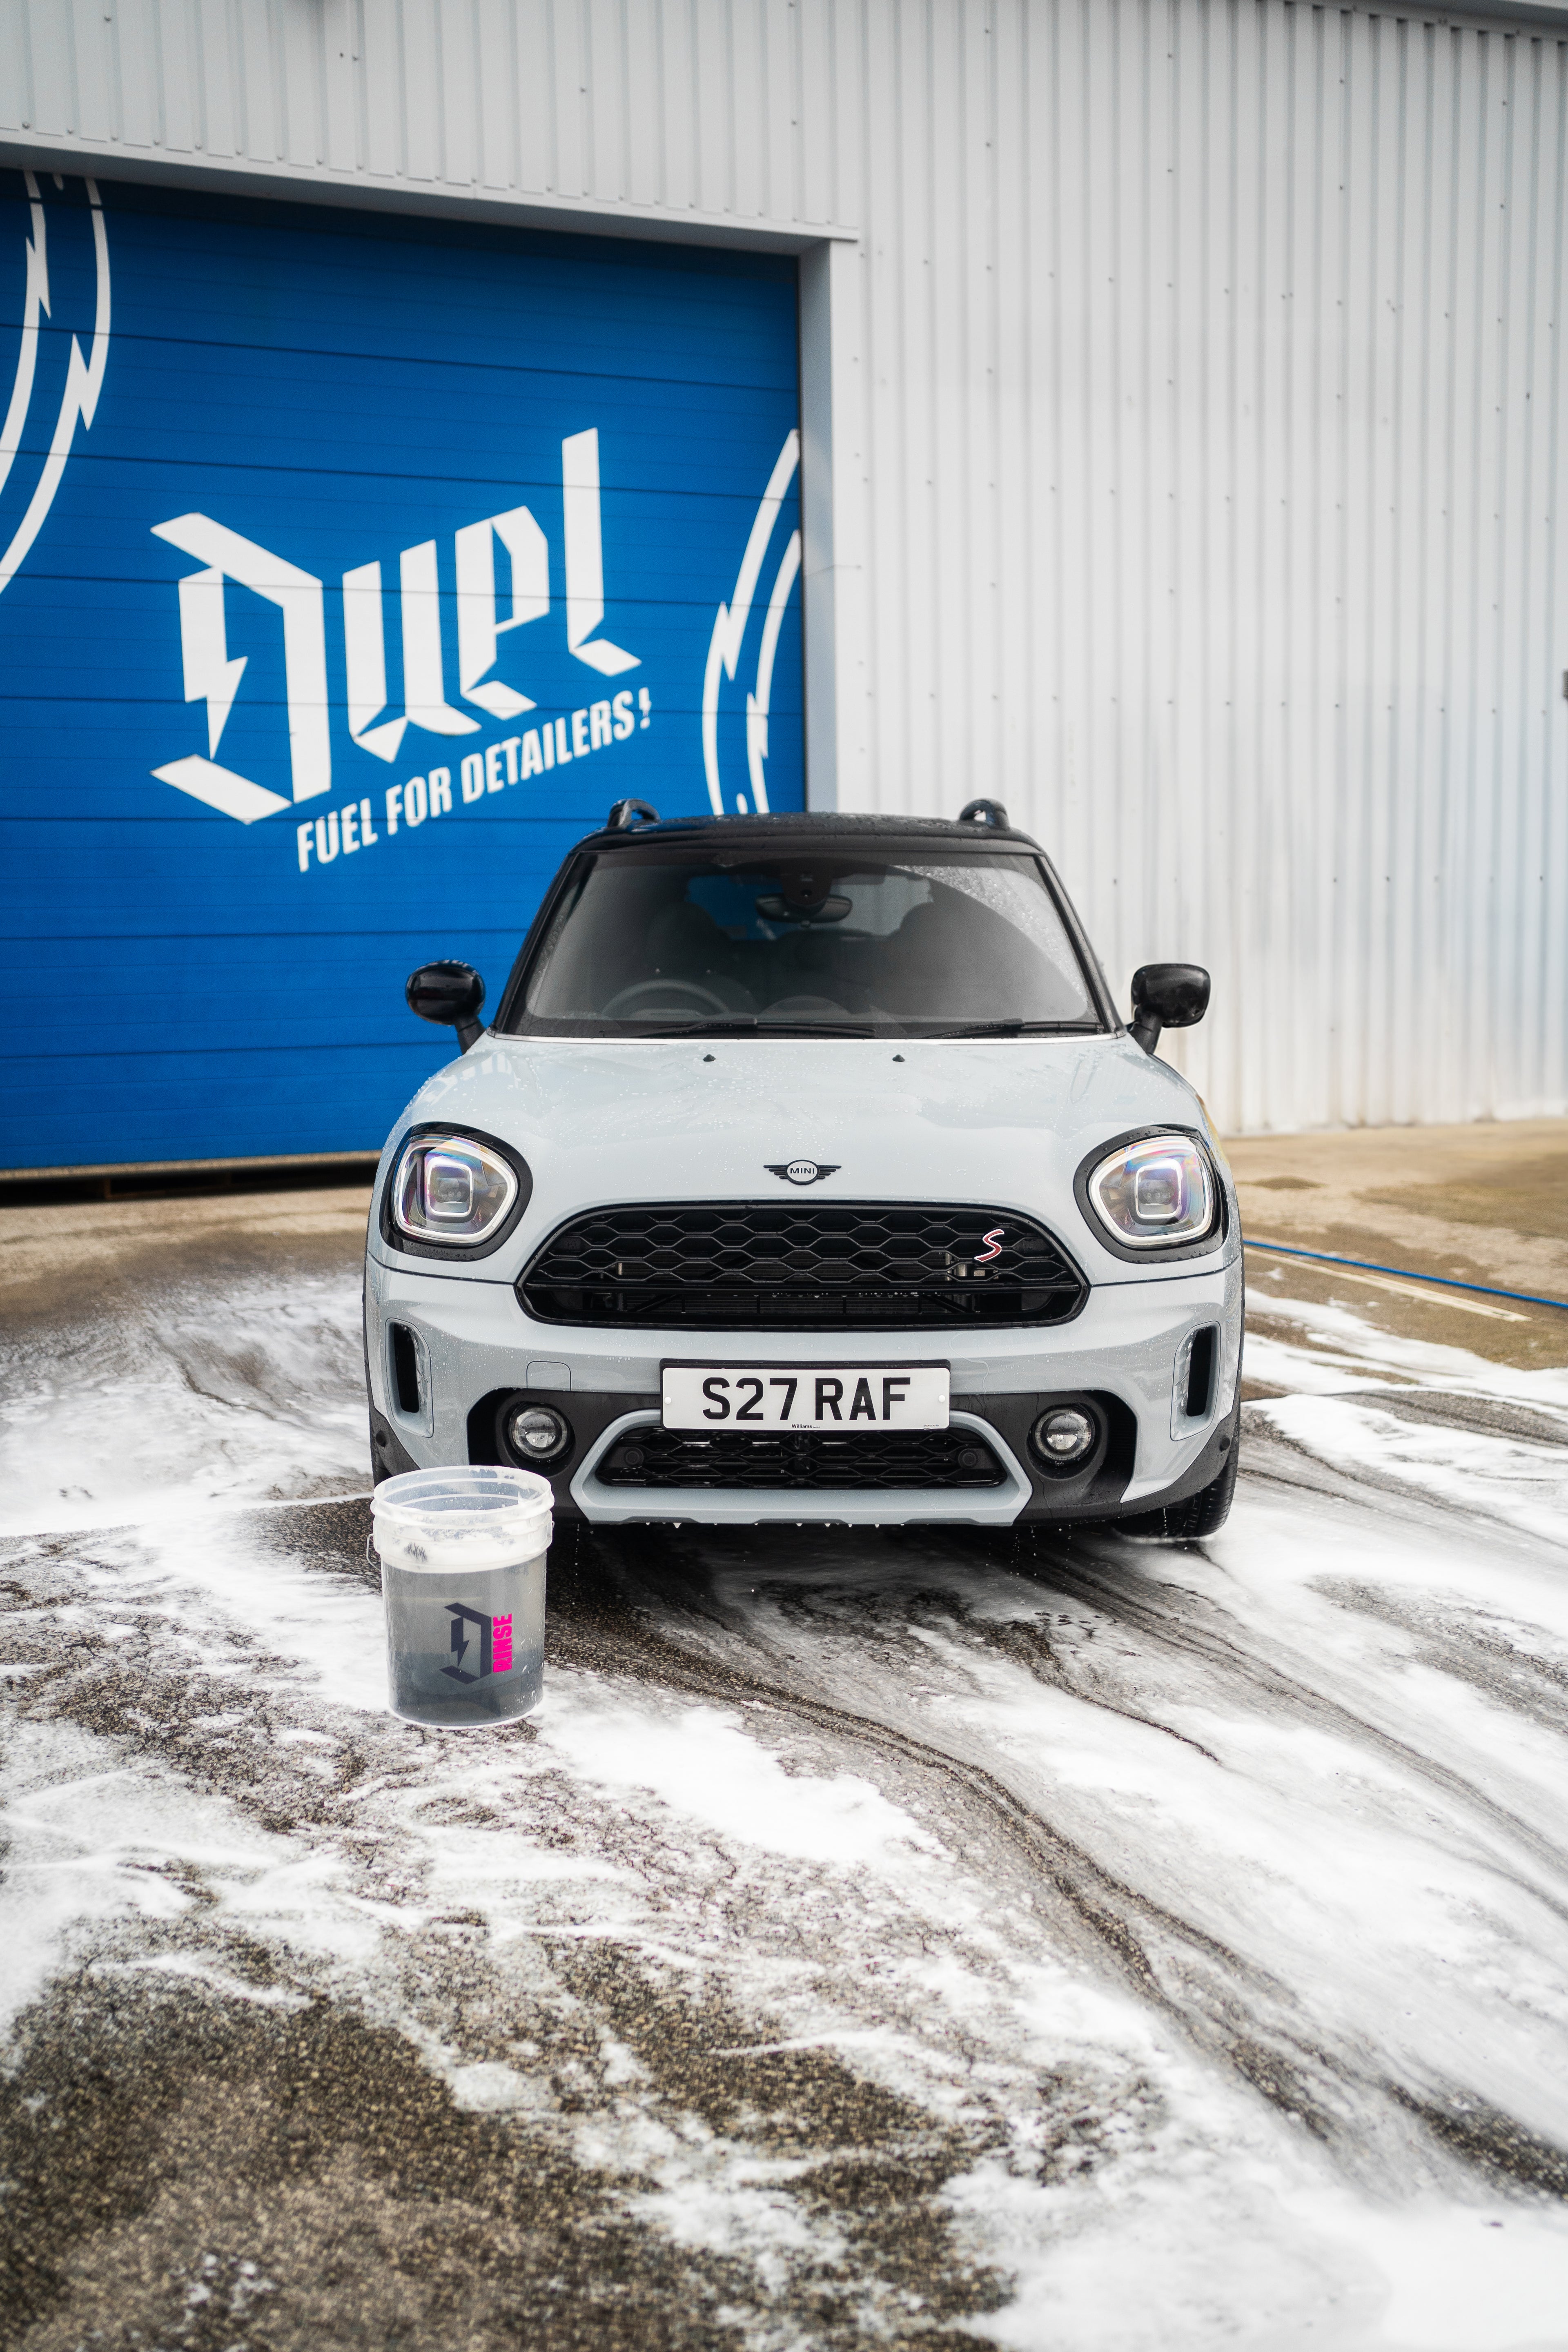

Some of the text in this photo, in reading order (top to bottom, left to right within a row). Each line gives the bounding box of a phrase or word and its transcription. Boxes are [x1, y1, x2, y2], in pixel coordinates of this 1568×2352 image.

[297, 688, 651, 872] FUEL FOR DETAILERS!
[702, 1377, 911, 1421] S27 RAF
[493, 1613, 512, 1673] RINSE
